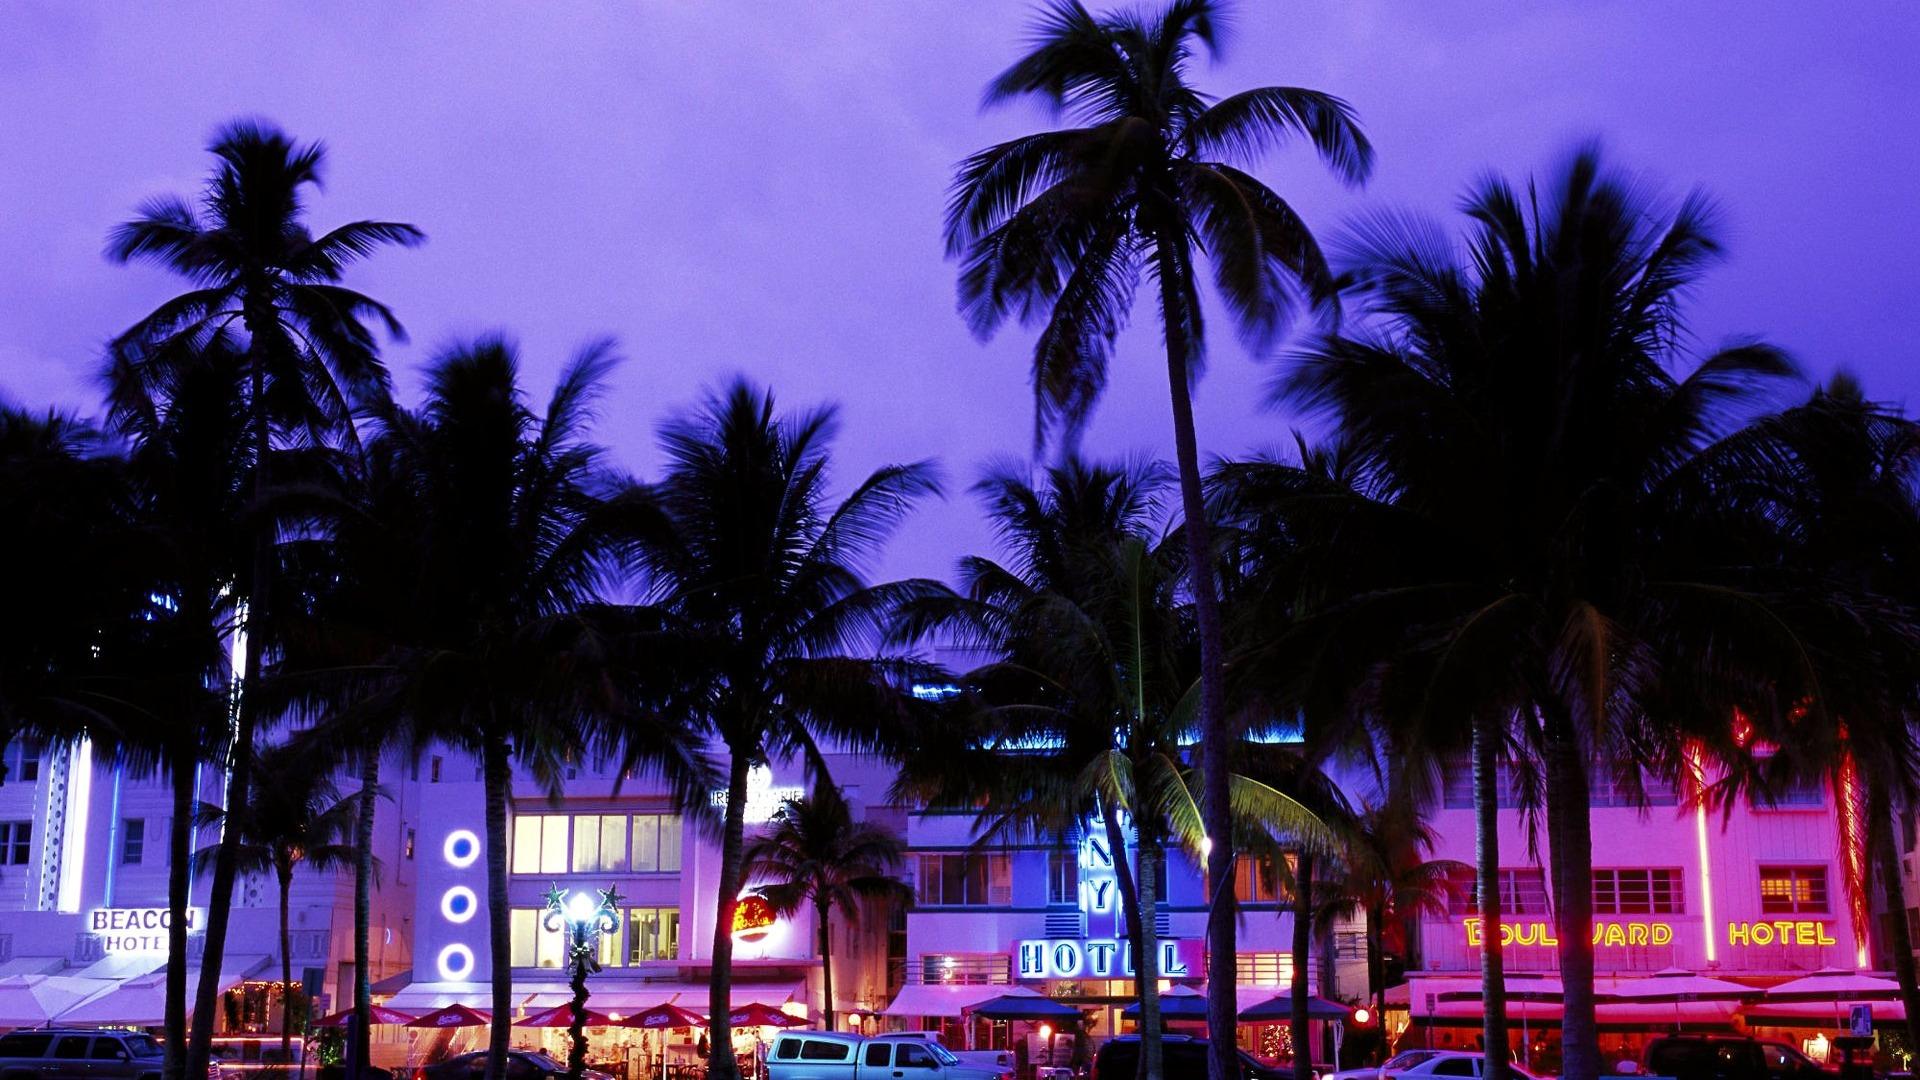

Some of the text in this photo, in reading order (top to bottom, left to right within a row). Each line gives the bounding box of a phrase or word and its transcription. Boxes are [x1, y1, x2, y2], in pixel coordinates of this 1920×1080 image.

[1463, 917, 1836, 946] BOULVARD HOTEL
[106, 936, 166, 951] HOTE
